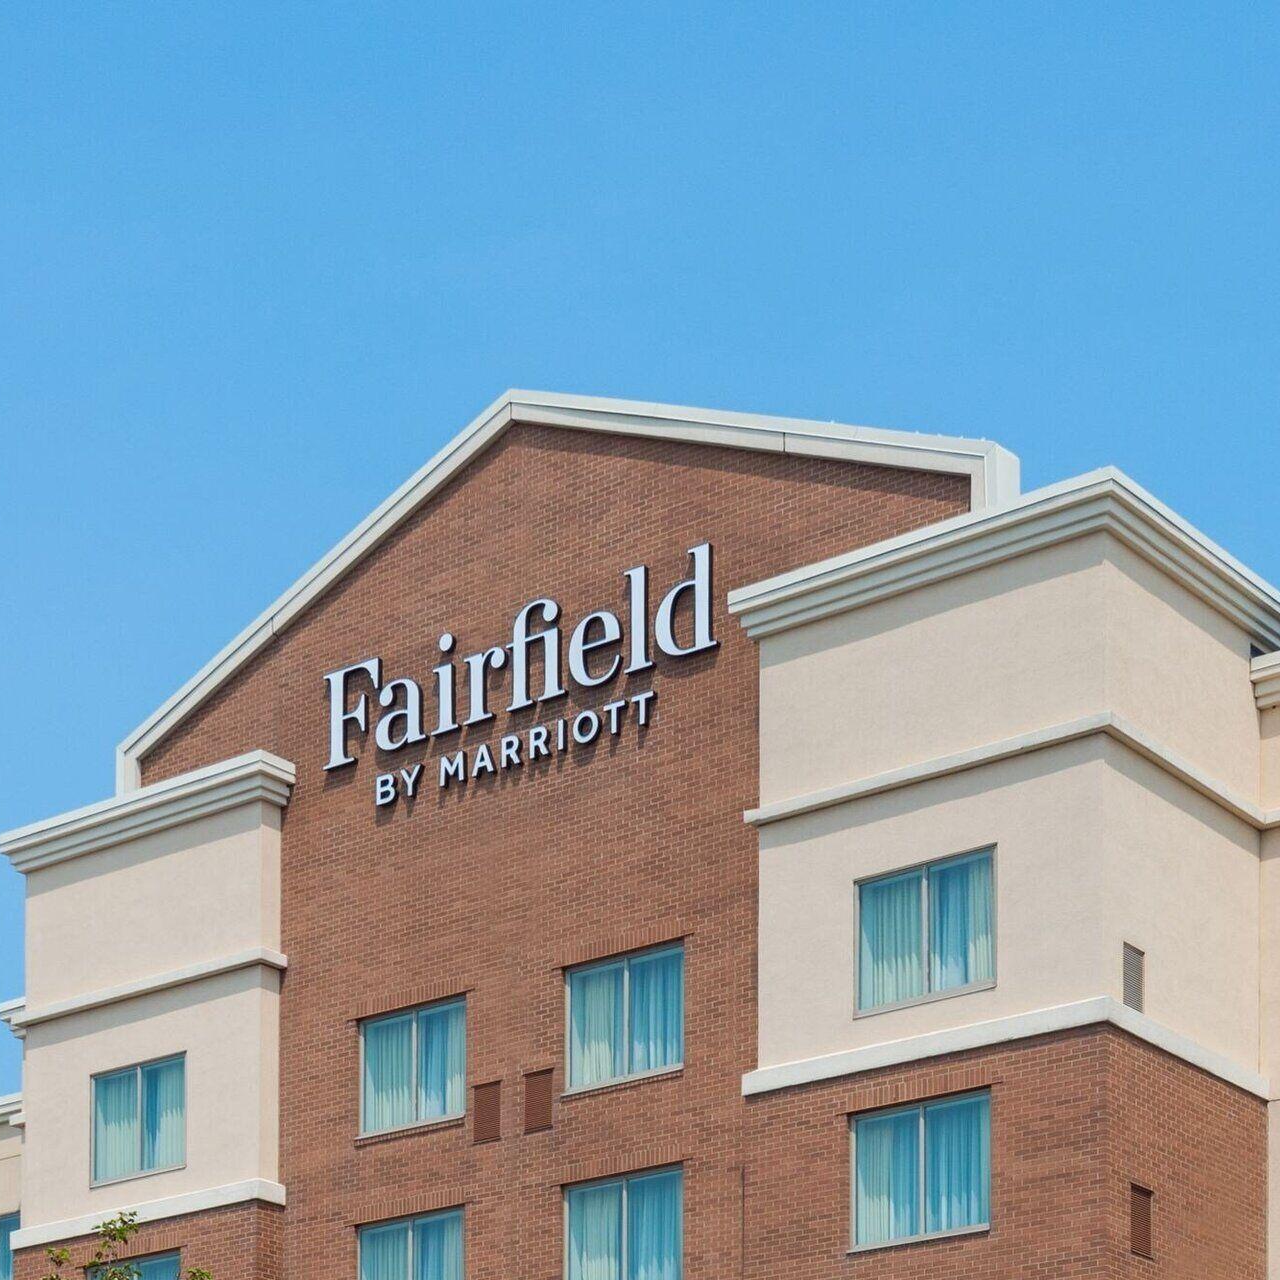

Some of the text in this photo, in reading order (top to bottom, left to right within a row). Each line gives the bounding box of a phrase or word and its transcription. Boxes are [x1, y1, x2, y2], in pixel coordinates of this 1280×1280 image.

[322, 541, 720, 771] Fairfield
[375, 690, 658, 807] BY MARRIOTT
